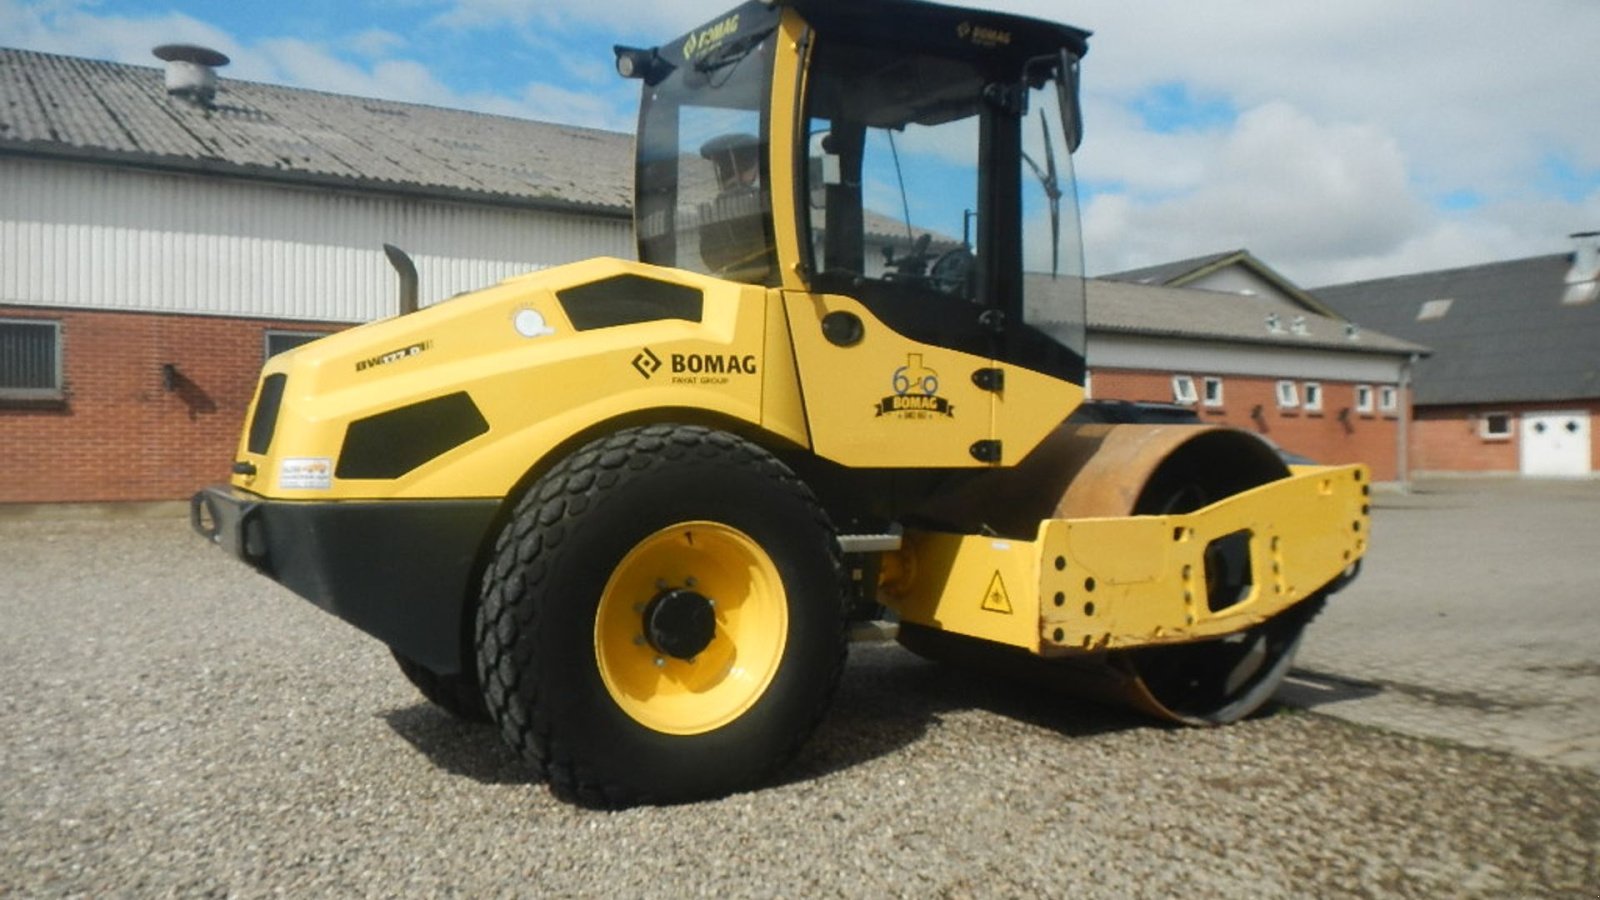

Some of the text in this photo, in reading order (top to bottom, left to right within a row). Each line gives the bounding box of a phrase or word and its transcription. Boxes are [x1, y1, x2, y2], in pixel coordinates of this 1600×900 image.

[671, 353, 757, 375] BOMAG
[700, 377, 729, 385] GROUP
[893, 396, 938, 410] BOMAG
